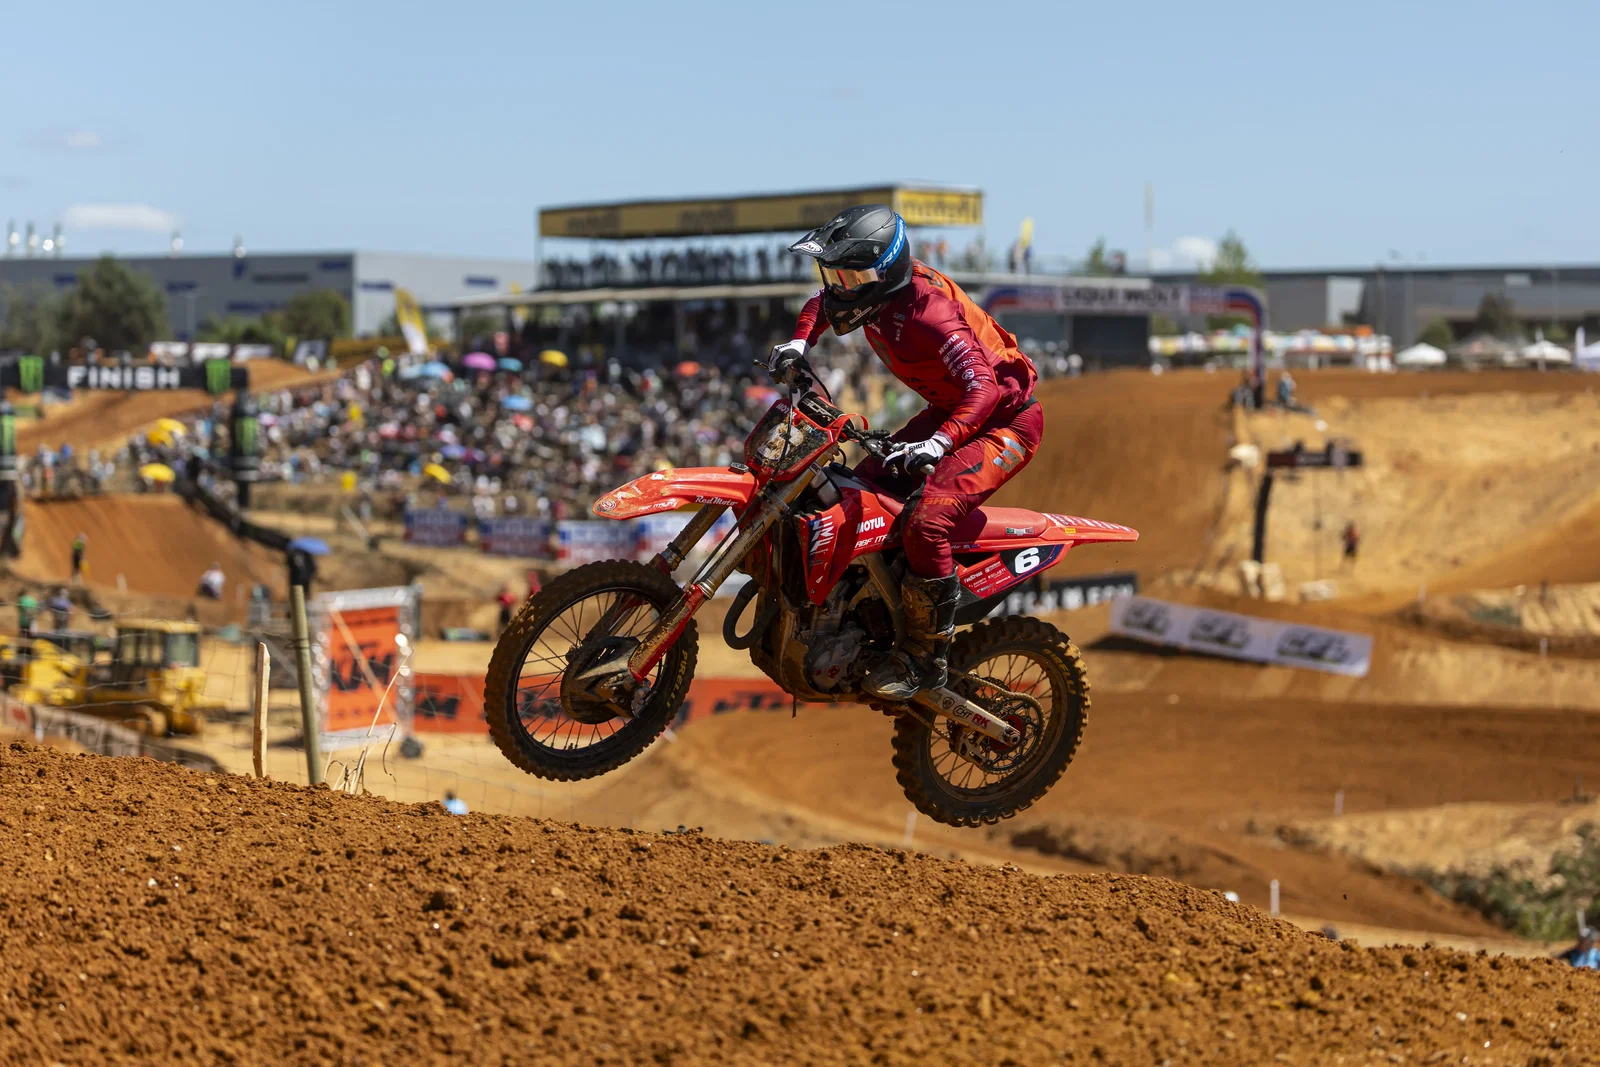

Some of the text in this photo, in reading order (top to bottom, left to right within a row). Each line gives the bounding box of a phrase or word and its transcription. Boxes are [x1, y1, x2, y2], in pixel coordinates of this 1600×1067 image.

[938, 333, 960, 355] MOTUL
[67, 365, 180, 389] FINISH
[856, 516, 886, 535] MOTUL
[1015, 547, 1040, 574] 6
[665, 649, 688, 709] PIRELLI
[971, 713, 991, 729] RK
